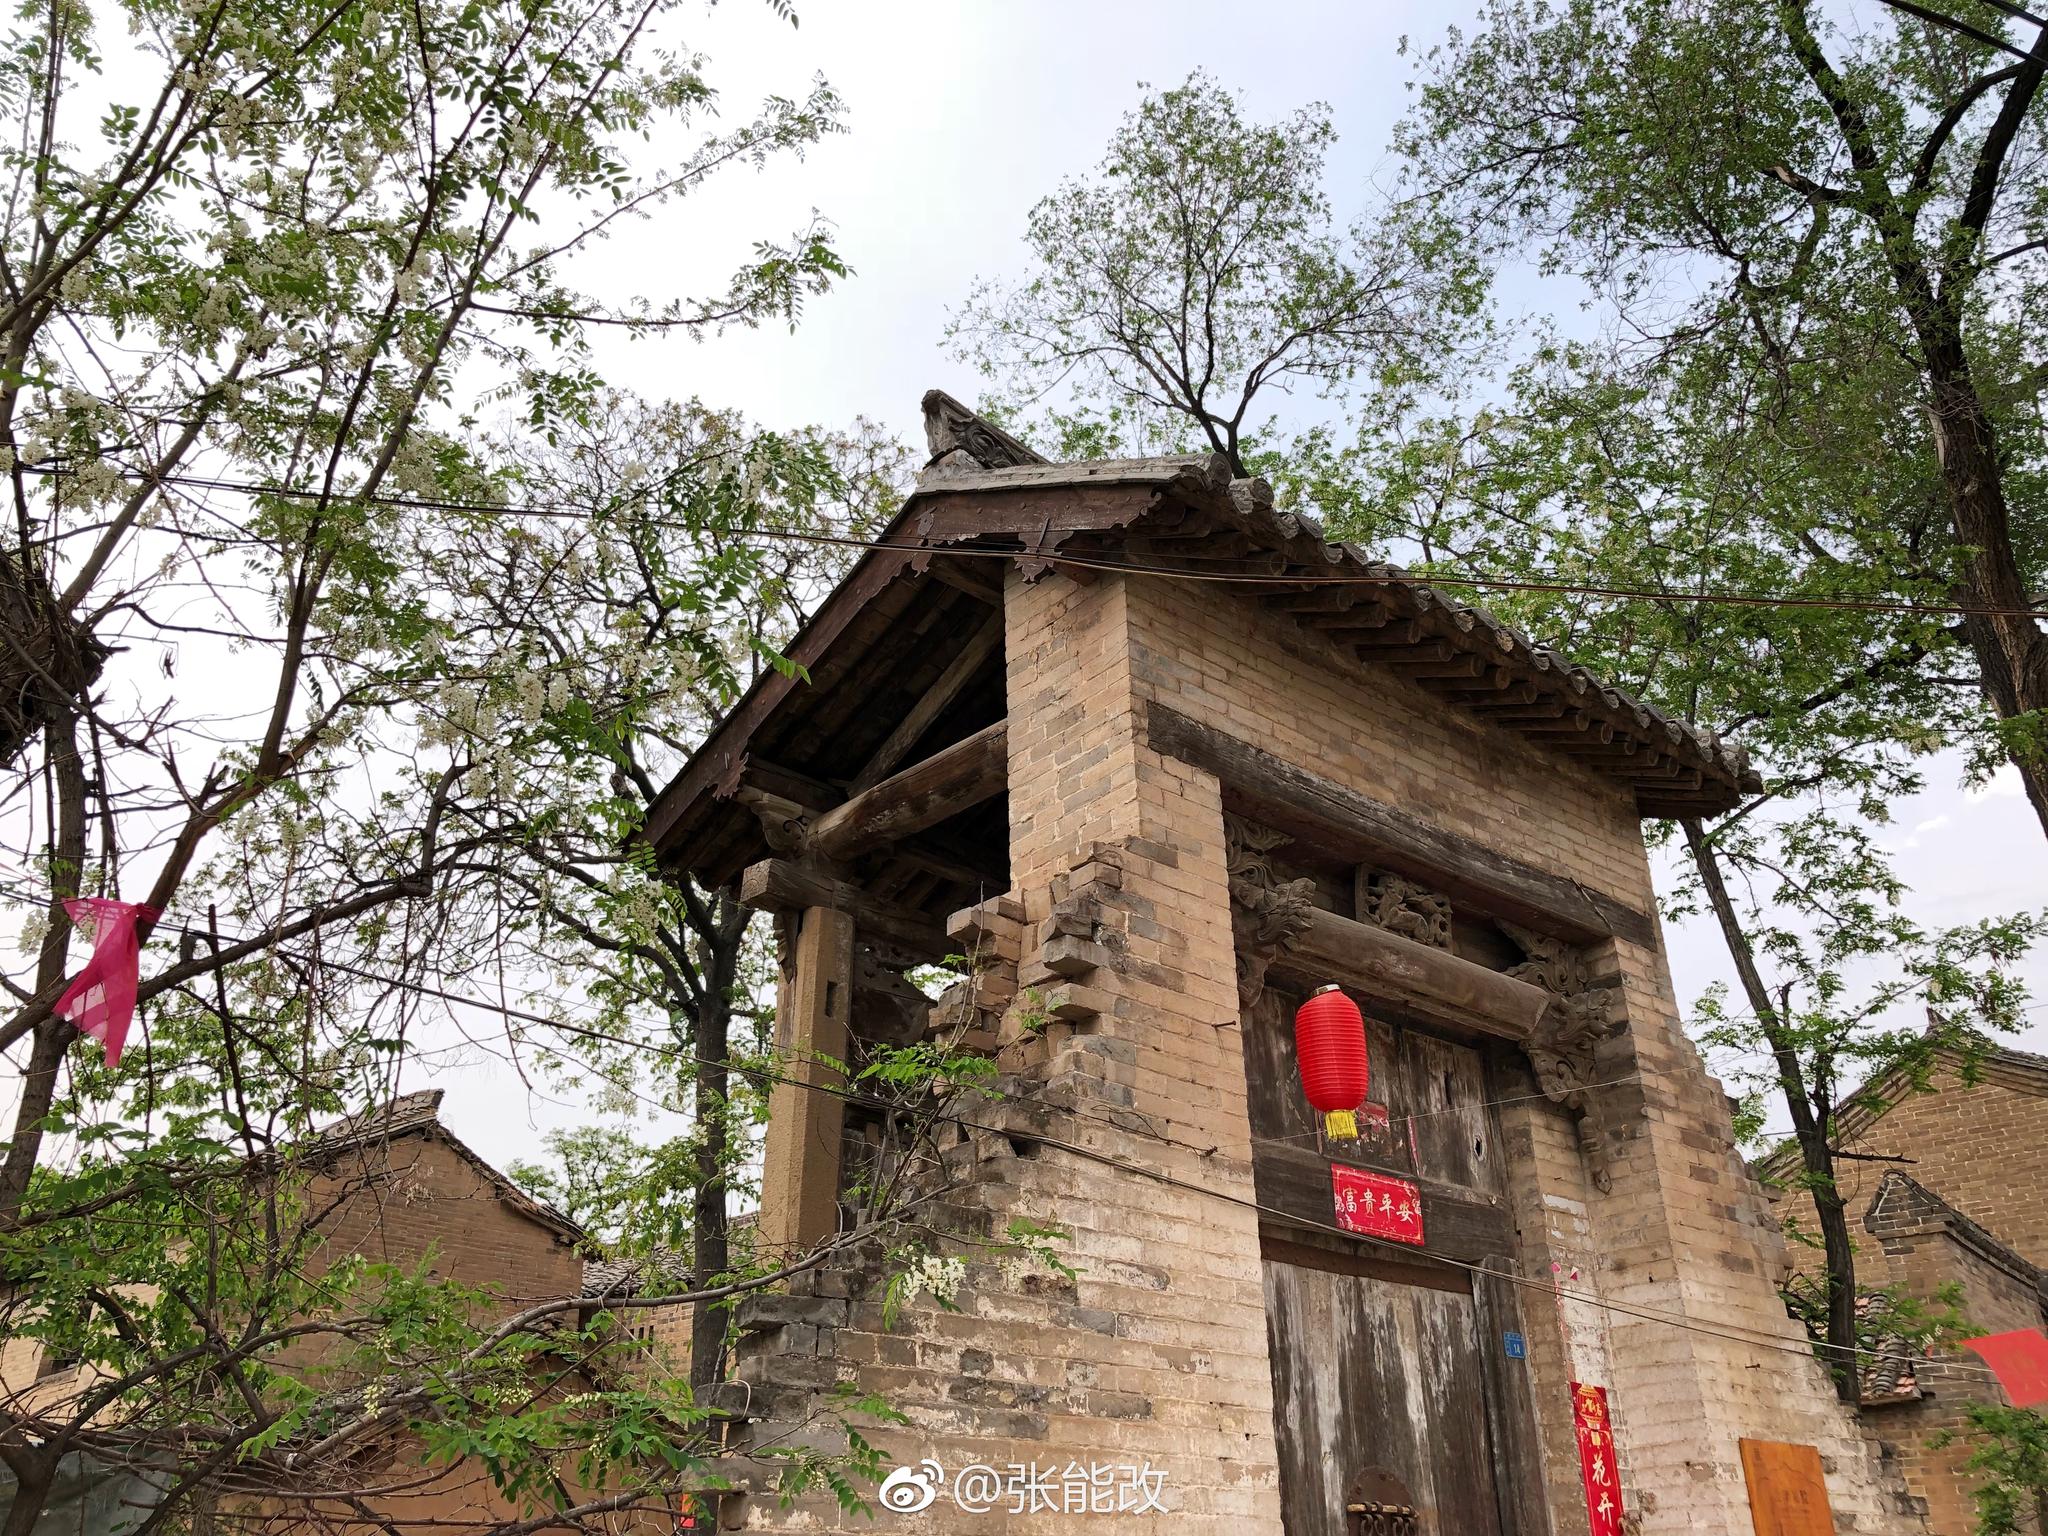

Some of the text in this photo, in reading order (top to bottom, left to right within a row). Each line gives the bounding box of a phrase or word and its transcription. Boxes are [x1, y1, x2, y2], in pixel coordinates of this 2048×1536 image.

[1342, 1186, 1414, 1225] 富贵平安
[1592, 1451, 1614, 1536] 花开
